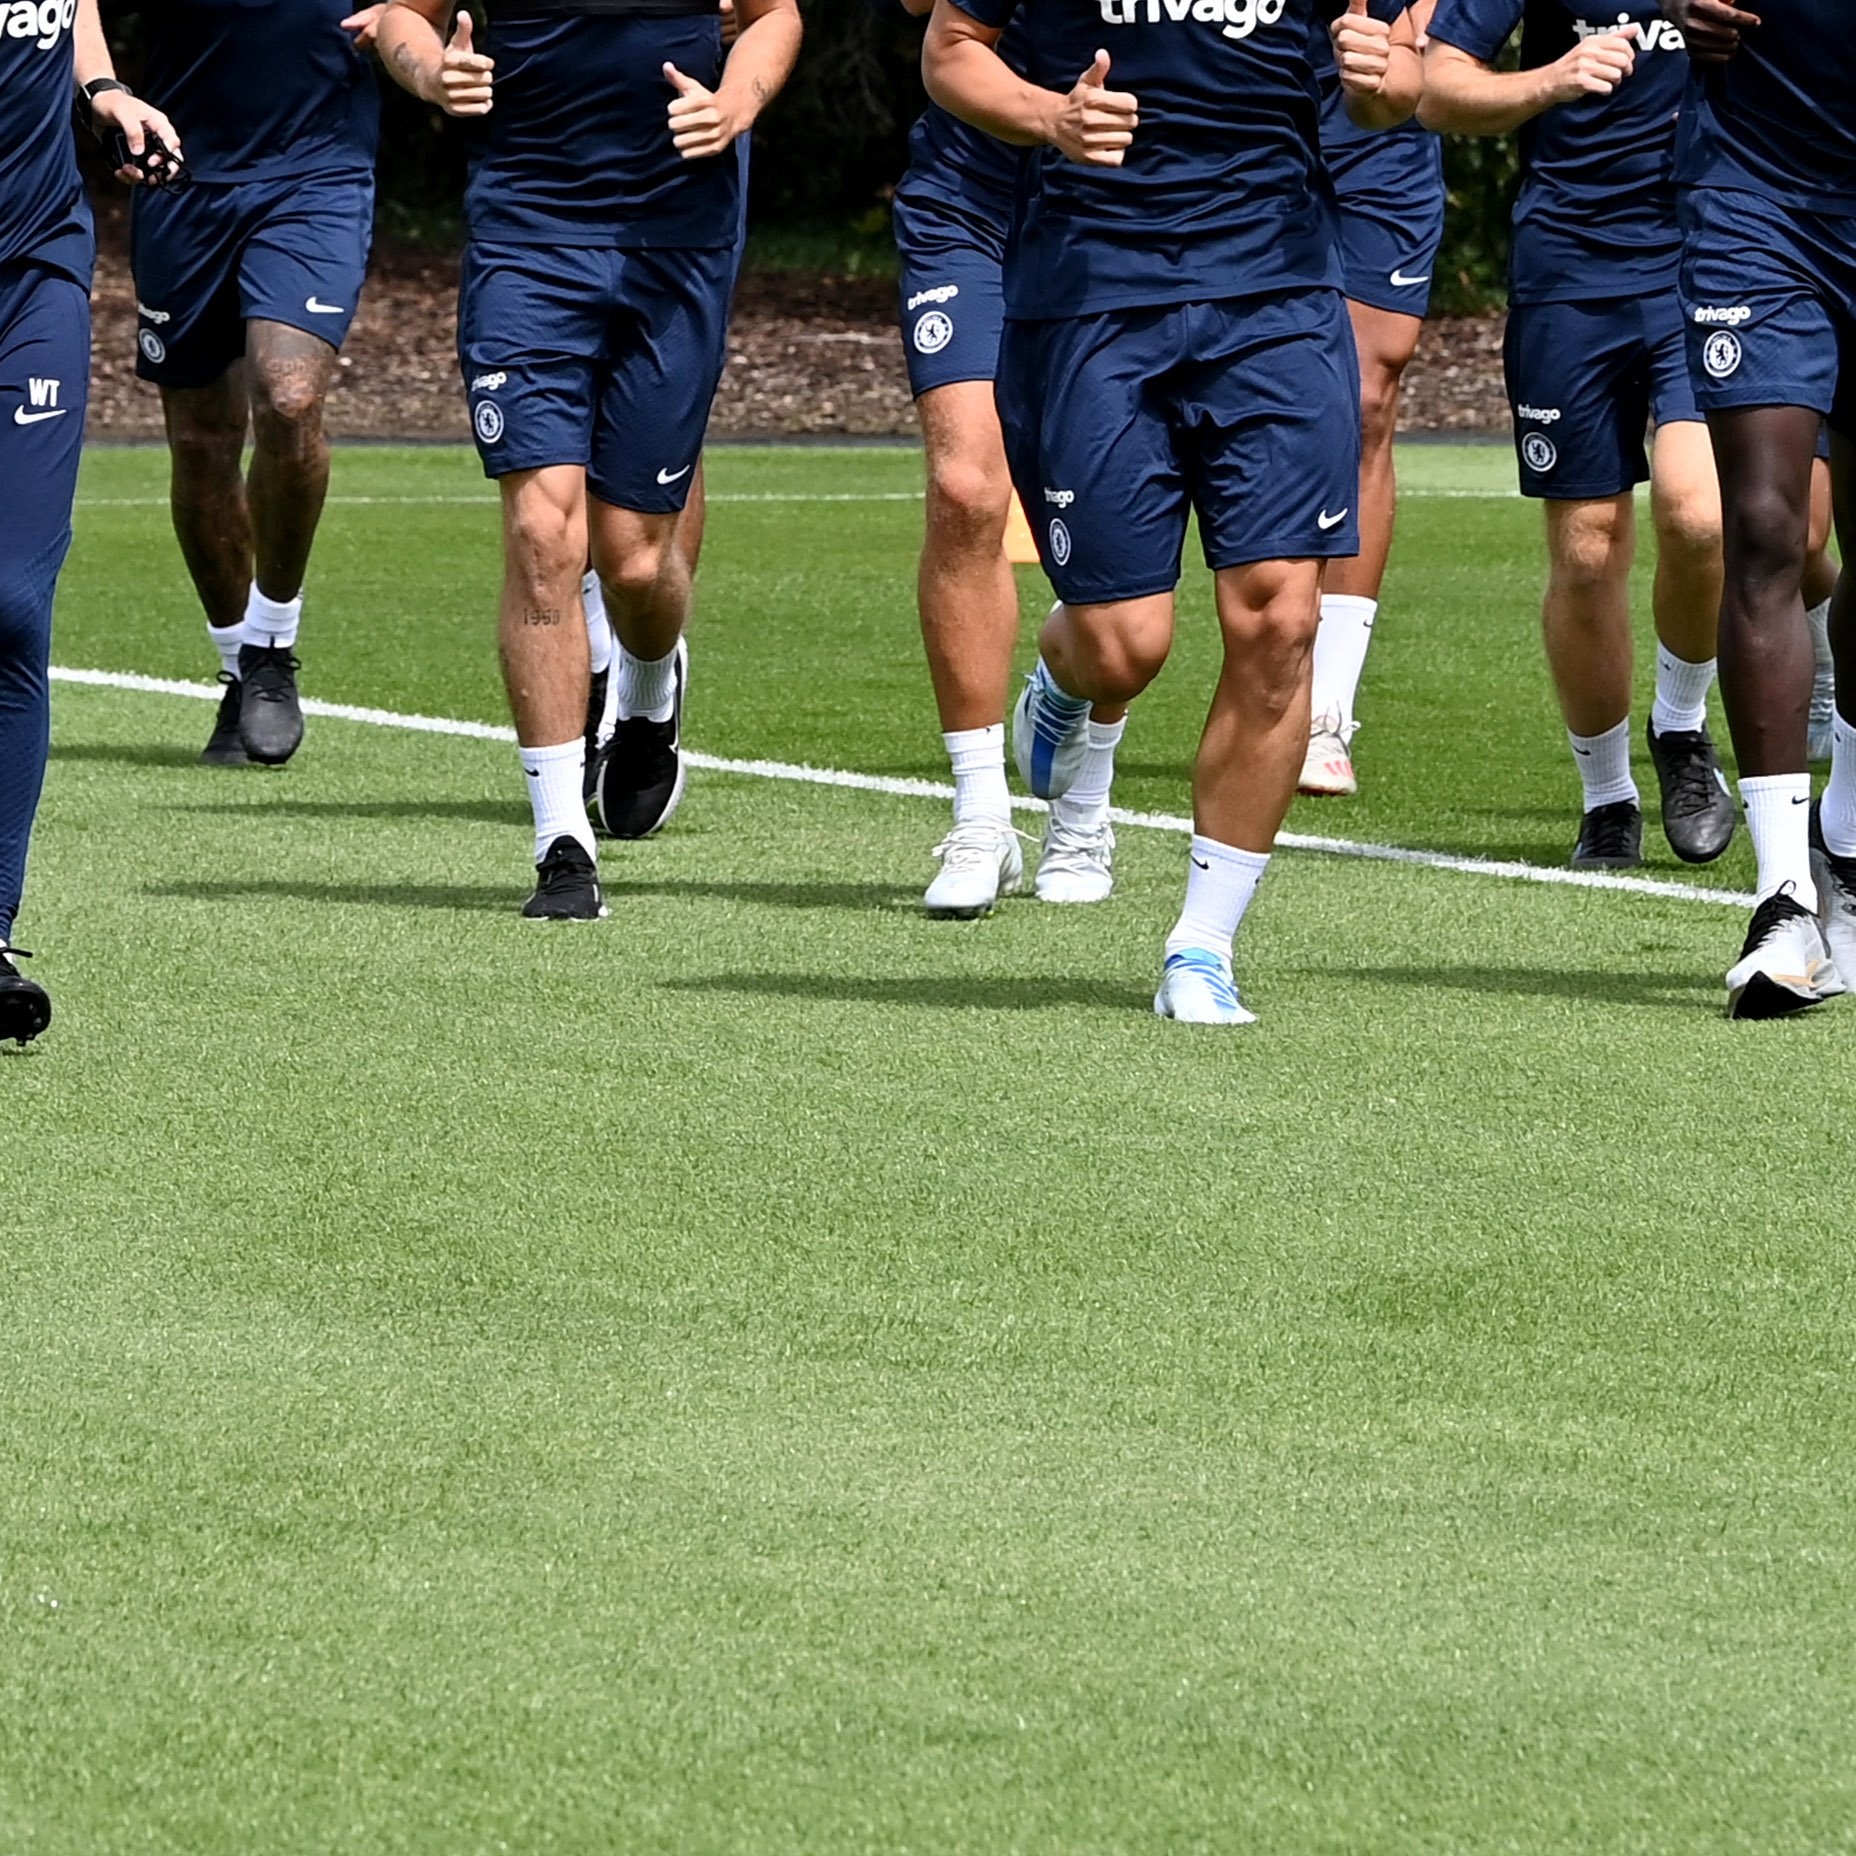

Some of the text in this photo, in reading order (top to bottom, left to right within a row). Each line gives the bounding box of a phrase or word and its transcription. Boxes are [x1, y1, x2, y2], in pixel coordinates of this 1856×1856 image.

[907, 284, 959, 311] trivago
[1693, 305, 1752, 326] trivago
[29, 377, 61, 406] WT
[1517, 404, 1561, 425] trivago
